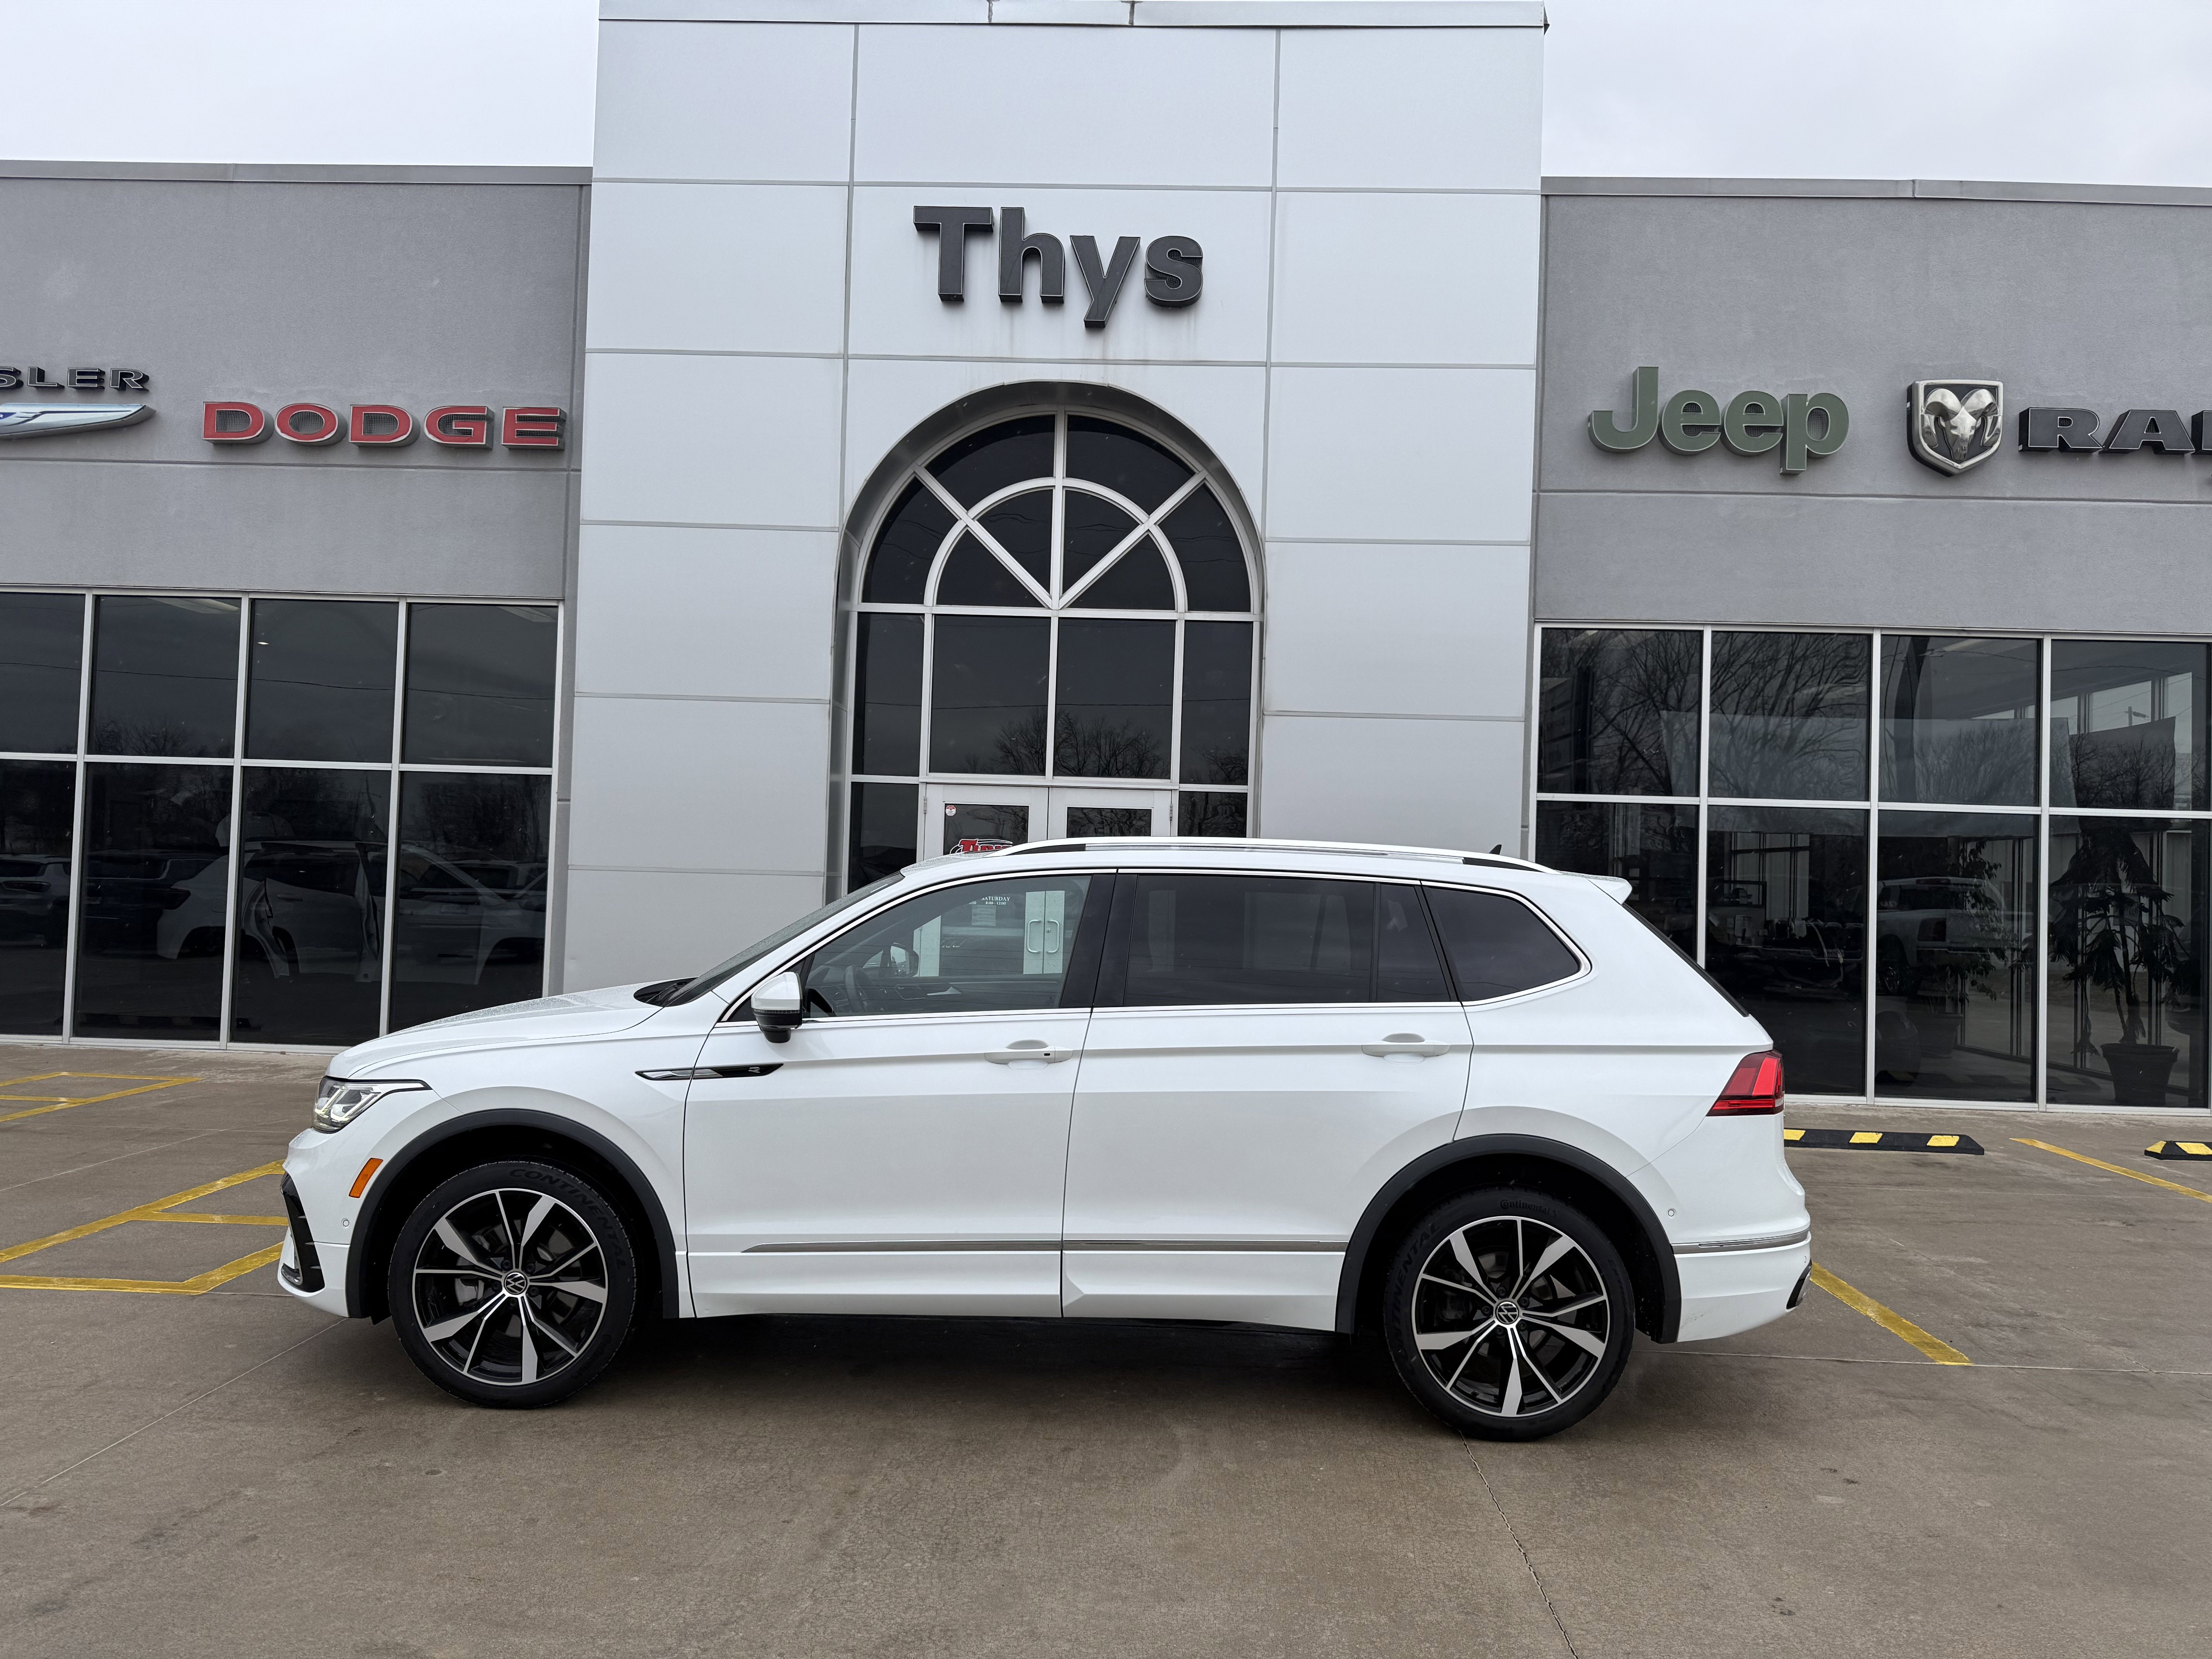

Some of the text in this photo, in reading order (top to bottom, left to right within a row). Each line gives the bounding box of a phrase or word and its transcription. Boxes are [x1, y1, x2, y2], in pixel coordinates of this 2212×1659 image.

[914, 205, 1204, 328] Thys
[203, 401, 566, 450] DODGE
[1587, 366, 1849, 475] Jeep
[2019, 407, 2212, 455] RA
[510, 1169, 627, 1269] CONTINENTAL
[1499, 1199, 1550, 1215] Continental
